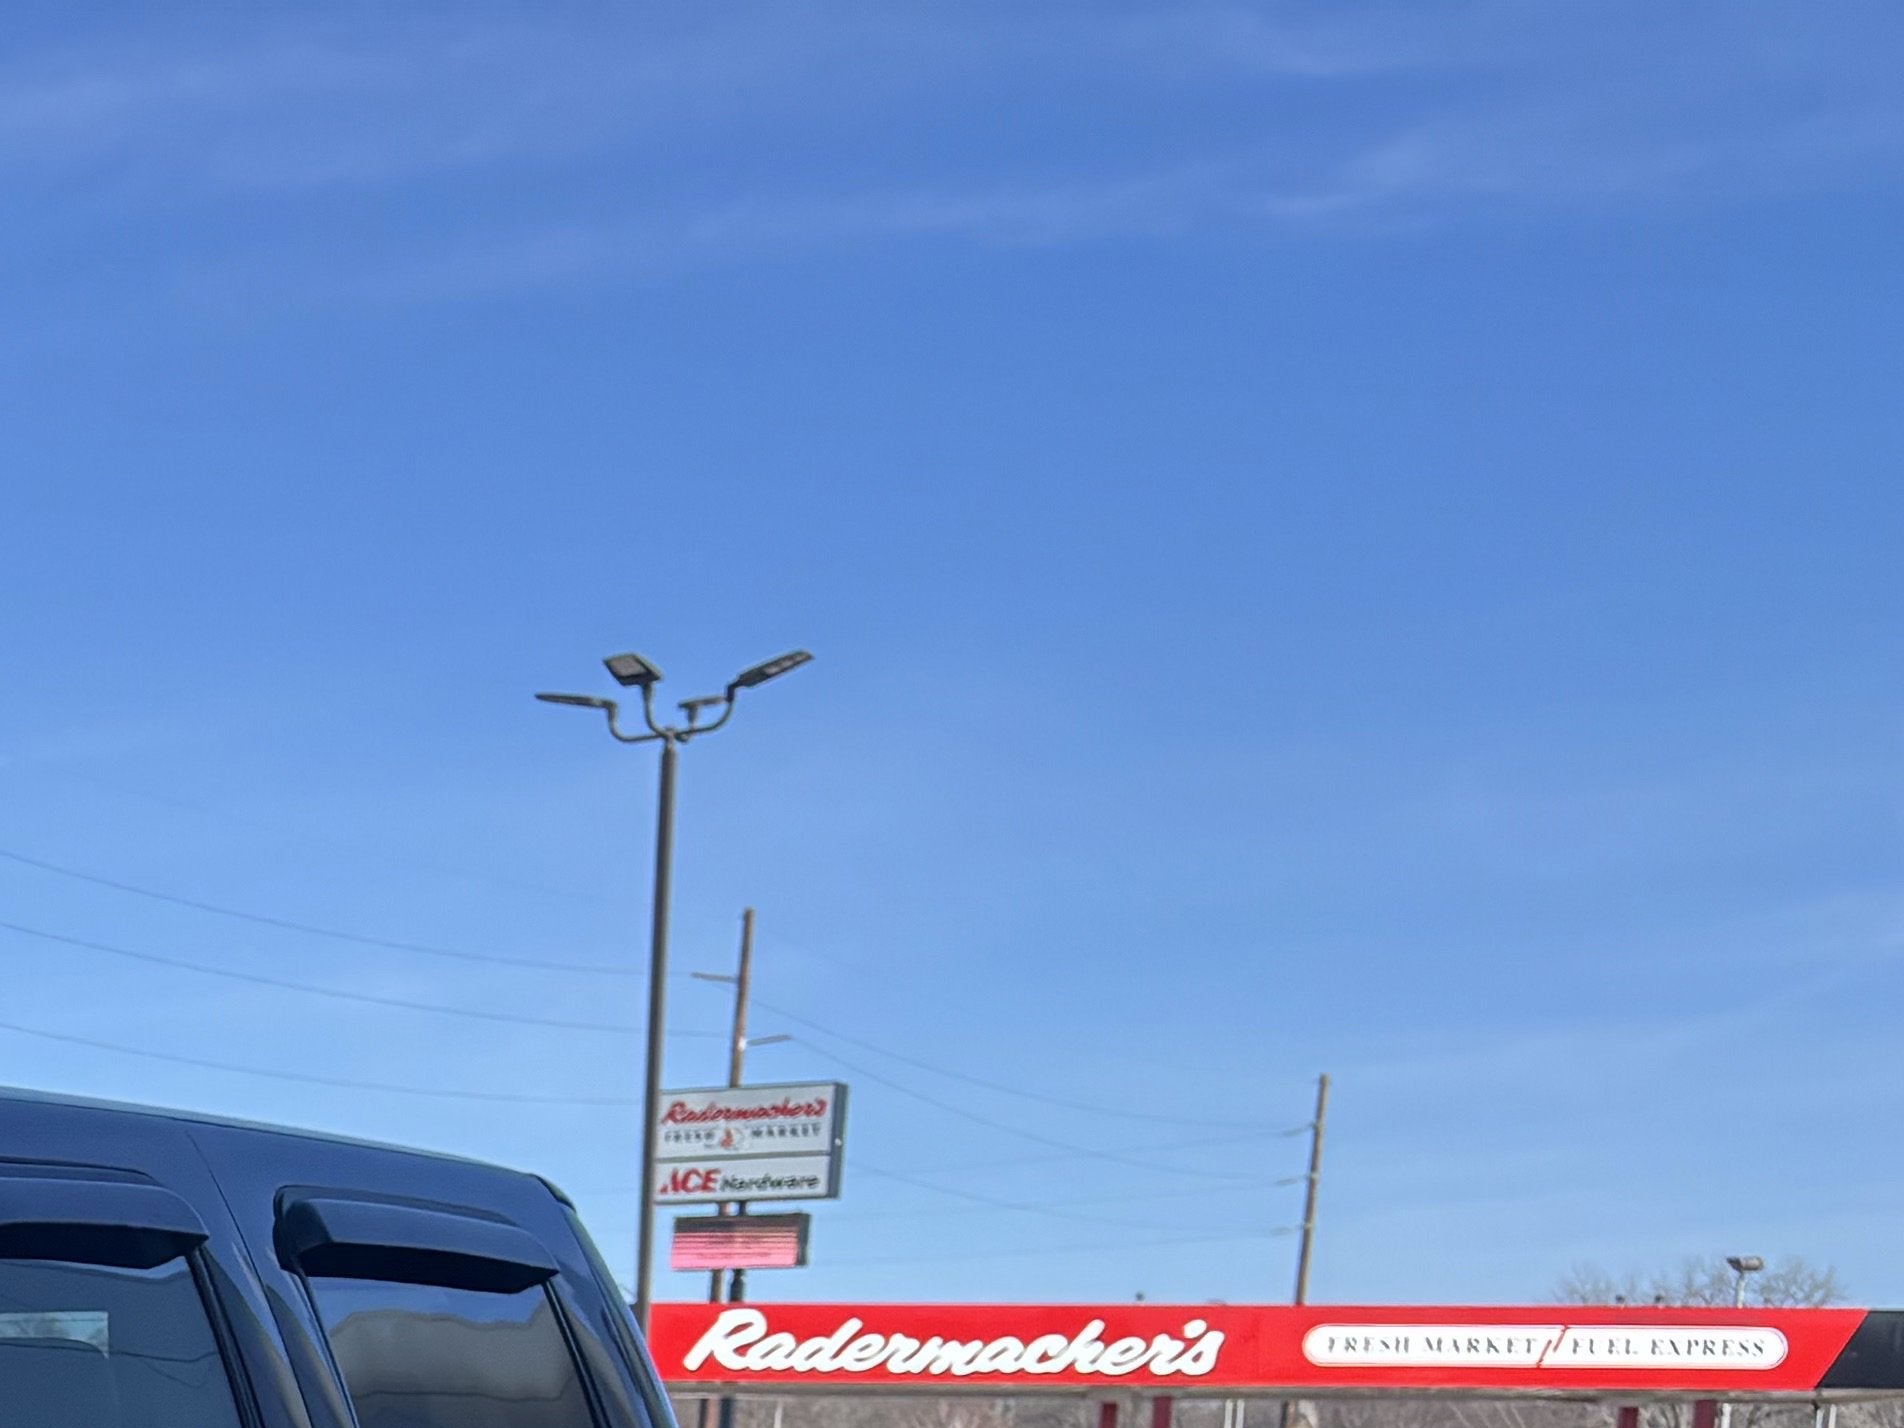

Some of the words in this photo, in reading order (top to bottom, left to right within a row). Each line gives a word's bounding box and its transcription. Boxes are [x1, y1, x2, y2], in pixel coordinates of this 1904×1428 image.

[659, 1167, 721, 1195] ACE
[720, 1173, 820, 1193] Hardware
[682, 1307, 1225, 1378] Radermacher's
[1326, 1335, 1411, 1355] FRESH
[1422, 1336, 1539, 1356] MARKET
[1571, 1336, 1640, 1356] FUEL
[1649, 1337, 1766, 1358] EXPRESS
